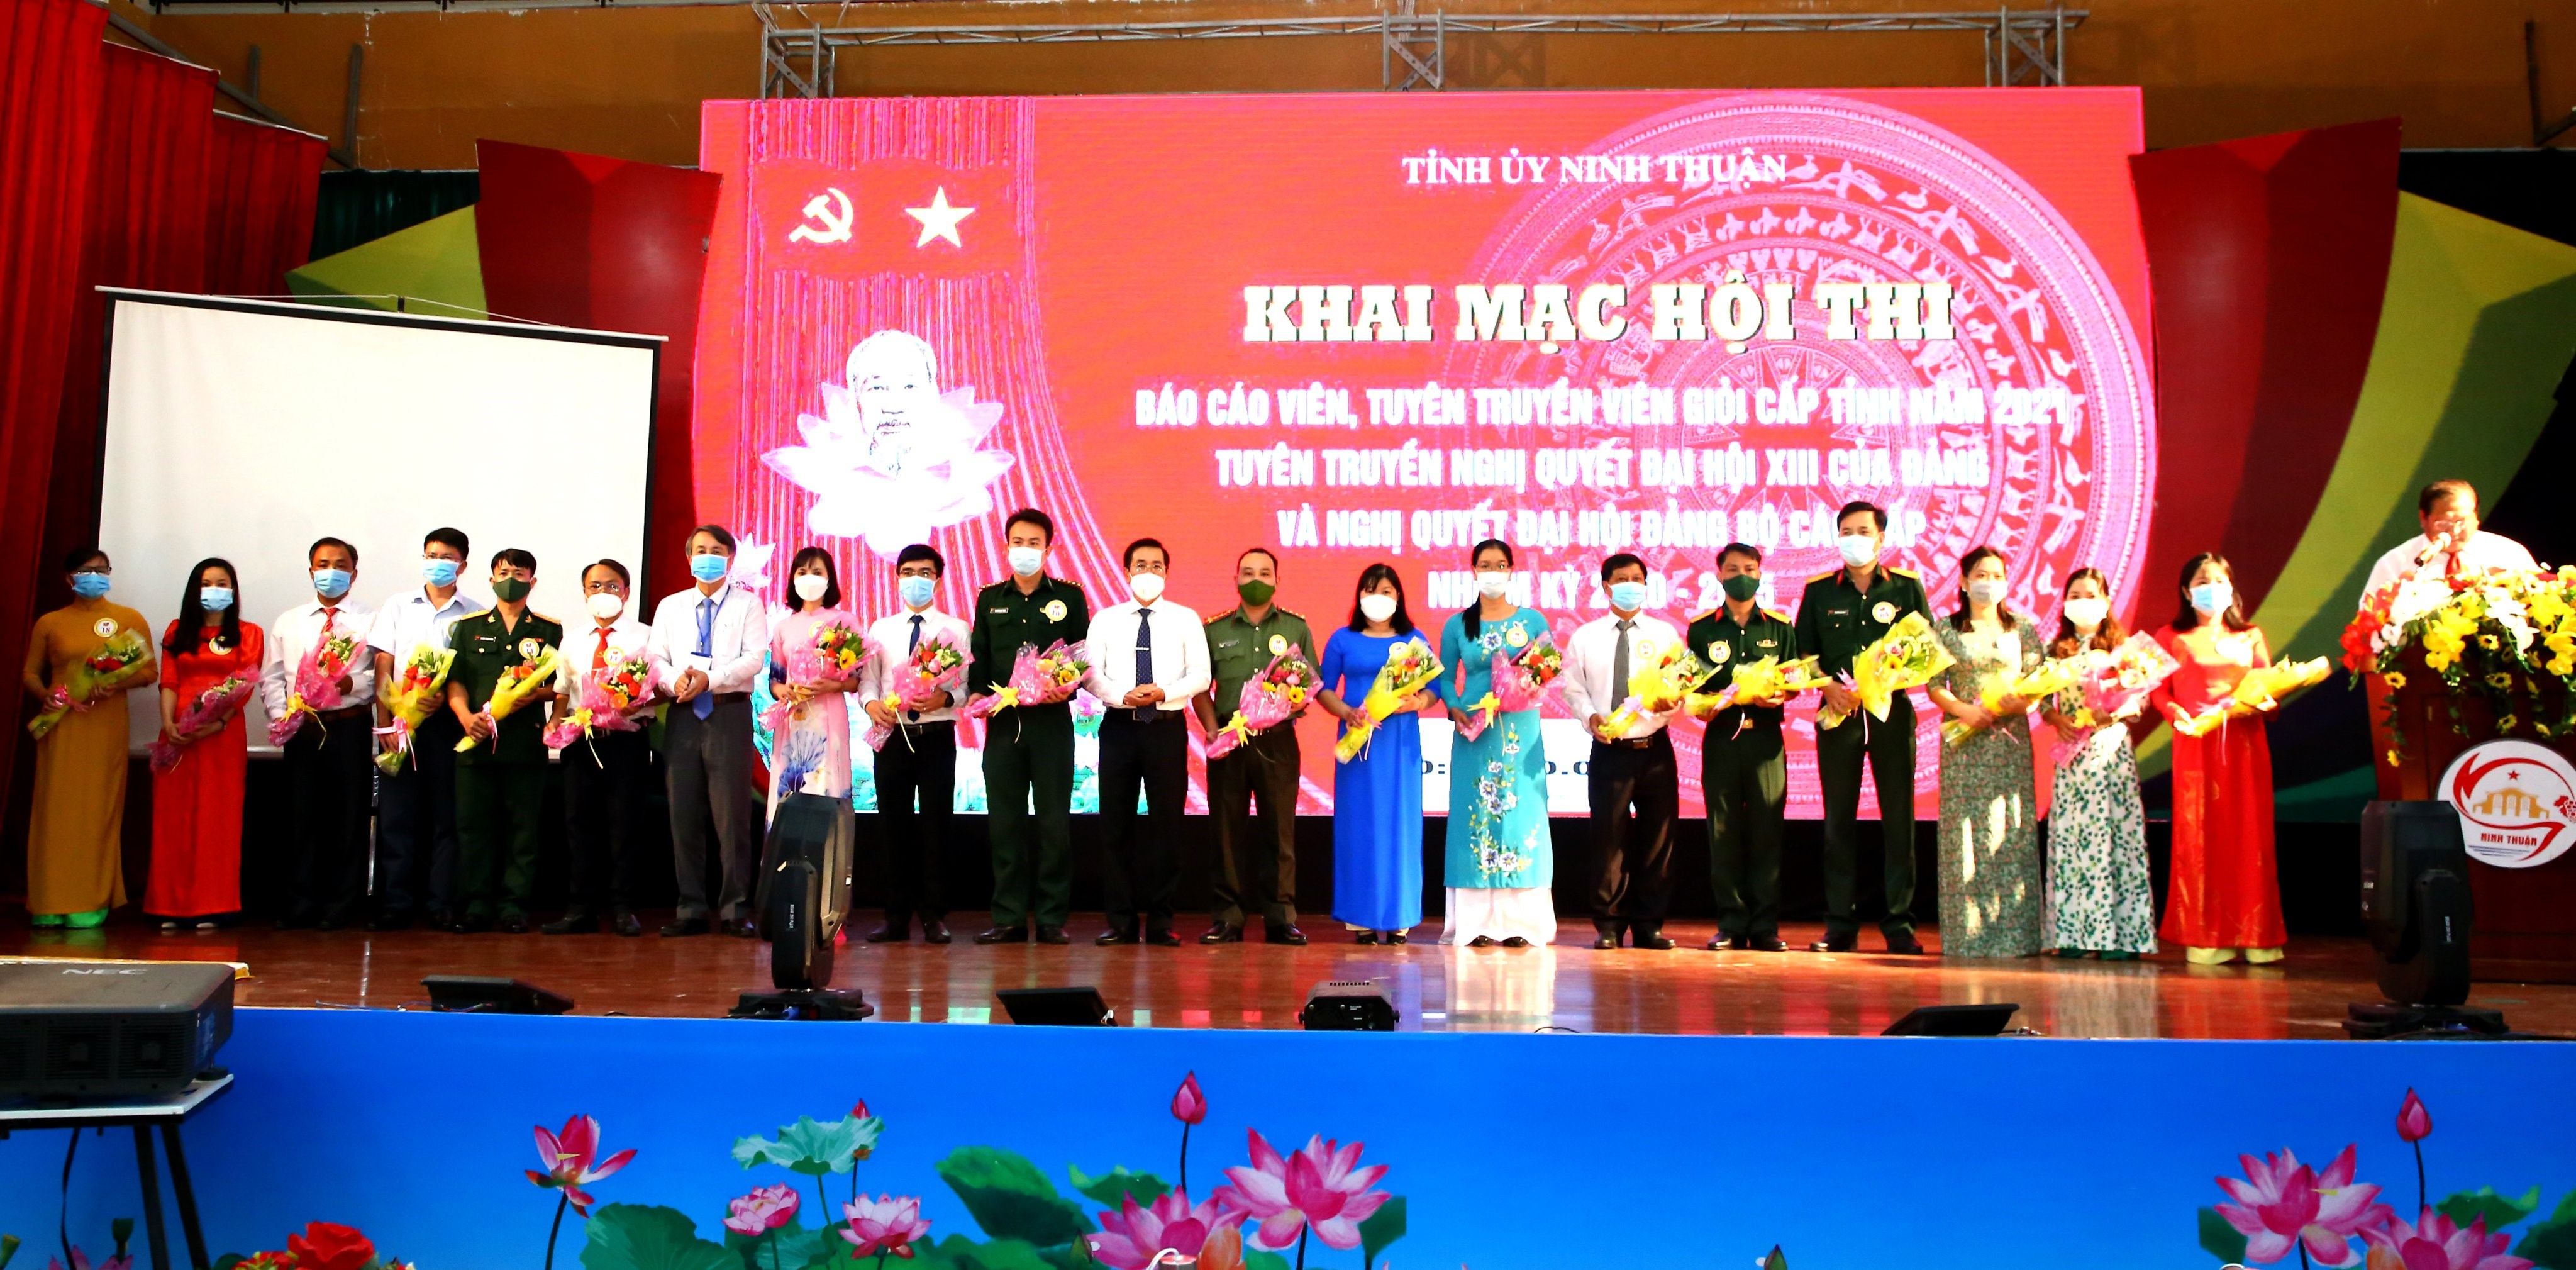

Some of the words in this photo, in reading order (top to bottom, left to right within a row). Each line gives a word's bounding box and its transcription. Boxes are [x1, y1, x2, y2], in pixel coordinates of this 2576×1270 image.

[1402, 148, 1491, 184] TỈNH
[1501, 148, 1550, 184] ỦY
[1560, 156, 1651, 184] NINH
[1660, 147, 1787, 189] THUẬN
[1243, 284, 1435, 342] KHAI
[1455, 284, 1628, 355] MẠC
[1651, 270, 1797, 355] HỘI
[1818, 283, 1956, 342] THI
[1135, 382, 1197, 426] BÁO
[1206, 381, 1270, 426] CÁO
[1277, 381, 1358, 430] VIÊN,
[1366, 381, 1467, 426] TUYÊN
[1474, 376, 1594, 426] TRUYỀN
[1601, 381, 1675, 426] VIÊN
[1682, 376, 1748, 426] GIỎI
[1755, 376, 1819, 425] CẤP
[1828, 376, 1901, 425] TỈNH
[1909, 379, 1985, 425] NĂM
[1992, 387, 2067, 425] 2021
[1214, 441, 1314, 486] TUYÊN
[1322, 438, 1443, 486] TRUYỀN
[1450, 448, 1526, 494] NGHỊ
[1535, 436, 1634, 491] QUYẾT
[1640, 448, 1695, 494] ĐẠI
[1703, 441, 1757, 494] HỘI
[1765, 448, 1819, 486] XIII
[1828, 437, 1893, 487] CỦA
[1901, 437, 1990, 487] ĐẢNG
[1276, 502, 1319, 547] VÀ
[1326, 510, 1402, 555] NGHỊ
[1410, 498, 1509, 551] QUYẾT
[1516, 510, 1570, 555] ĐẠI
[1579, 503, 1632, 555] HỘI
[1640, 498, 1729, 548] ĐẢNG
[1737, 502, 1780, 554] BỘ
[1789, 502, 1840, 548] CÁ
[1884, 498, 1927, 548] ẤP
[1541, 564, 1581, 610] KỲ
[2480, 833, 2504, 843] NINH
